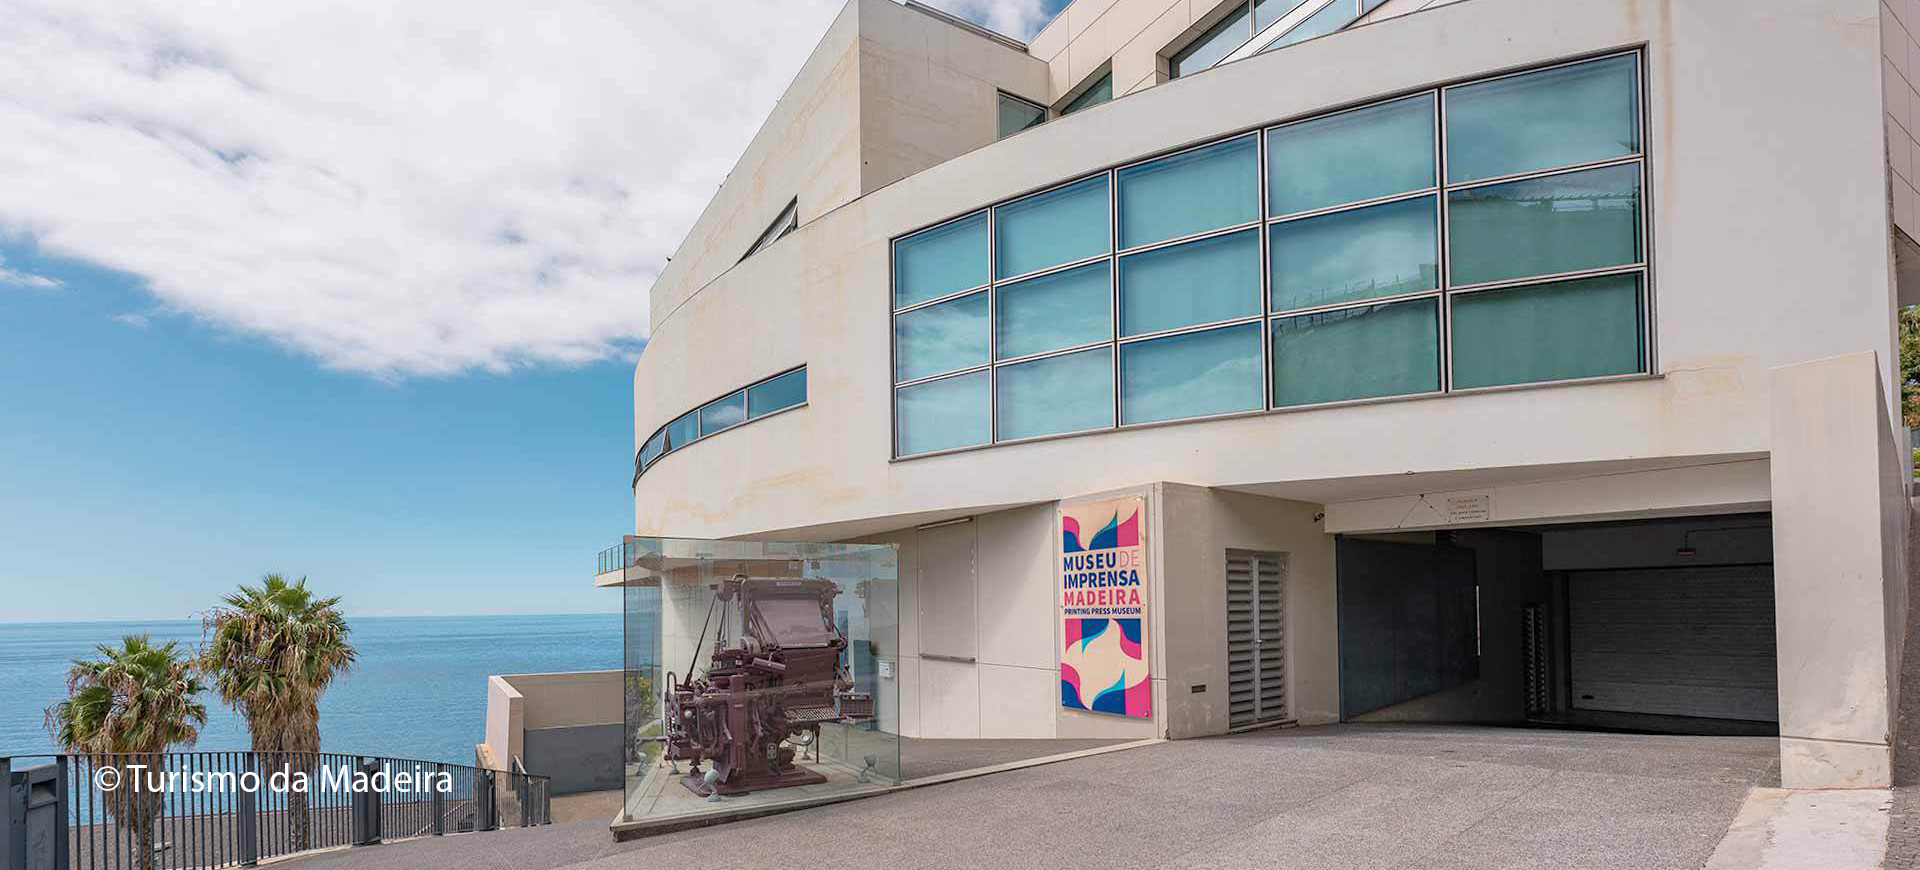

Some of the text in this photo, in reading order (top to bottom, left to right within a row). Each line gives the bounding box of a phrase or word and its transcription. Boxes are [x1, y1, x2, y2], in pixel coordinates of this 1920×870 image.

[1064, 550, 1140, 571] MUSEU DE
[1064, 569, 1140, 589] IMPRENSA
[1064, 589, 1140, 606] MADEIRA
[1091, 607, 1111, 615] PRESS
[1112, 607, 1141, 615] MUSEUM
